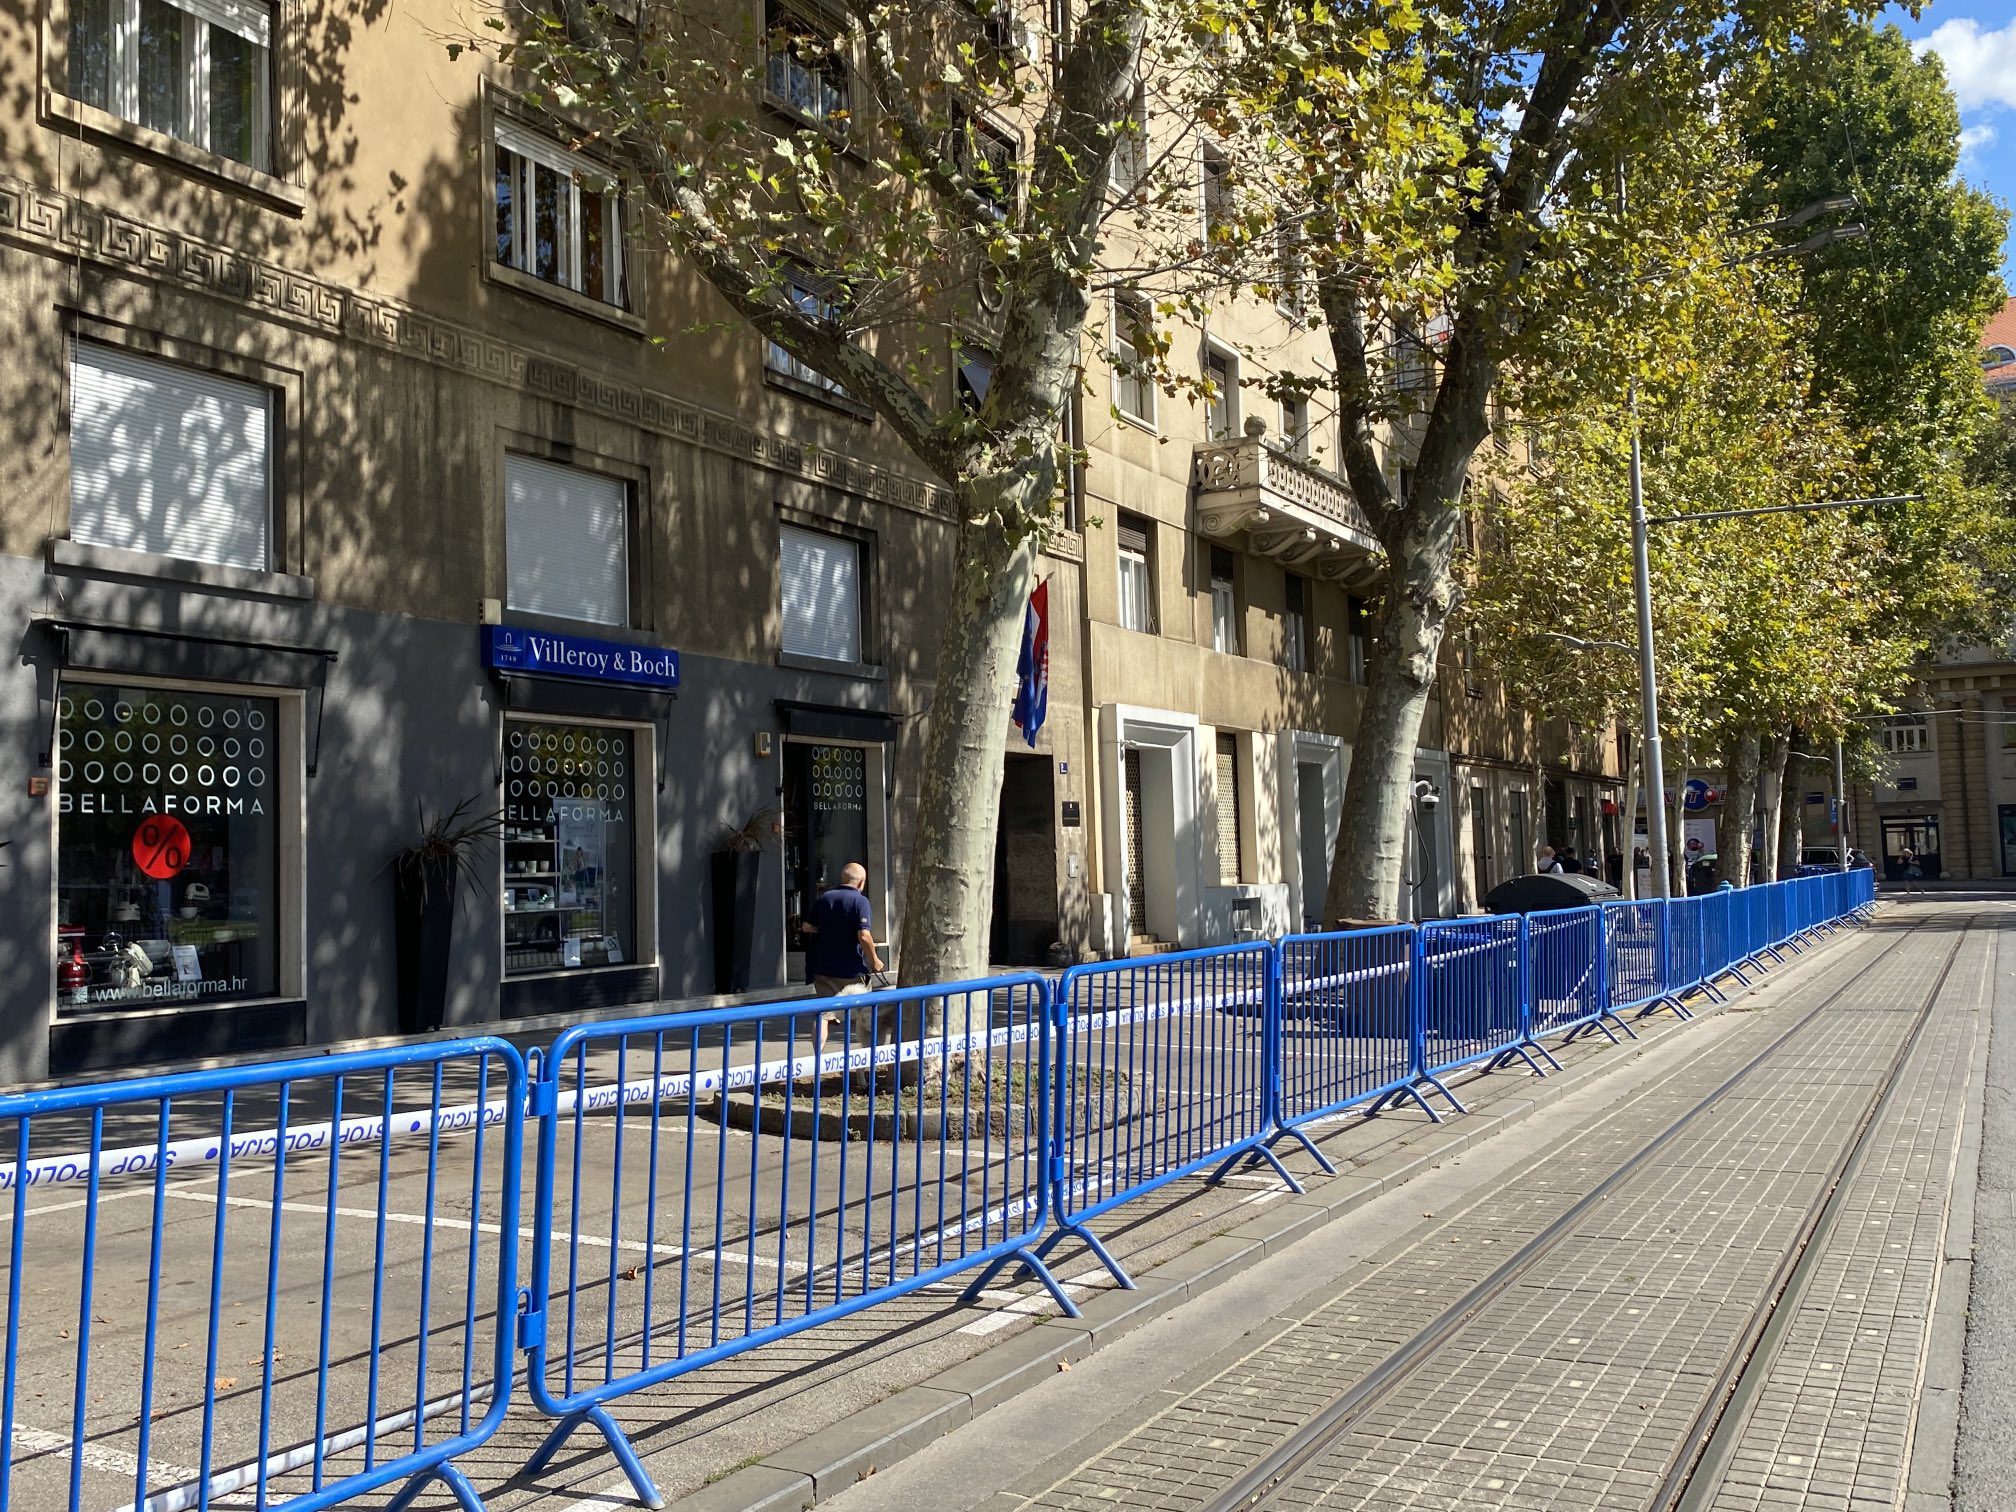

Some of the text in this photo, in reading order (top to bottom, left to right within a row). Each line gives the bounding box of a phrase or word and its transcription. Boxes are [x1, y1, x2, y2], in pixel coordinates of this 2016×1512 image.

[529, 636, 676, 677] Villeroy & Boch
[59, 793, 264, 815] BELLAFORMA
[813, 802, 863, 811] BELLAFORMA
[96, 976, 248, 1002] www.bellaforma.hr
